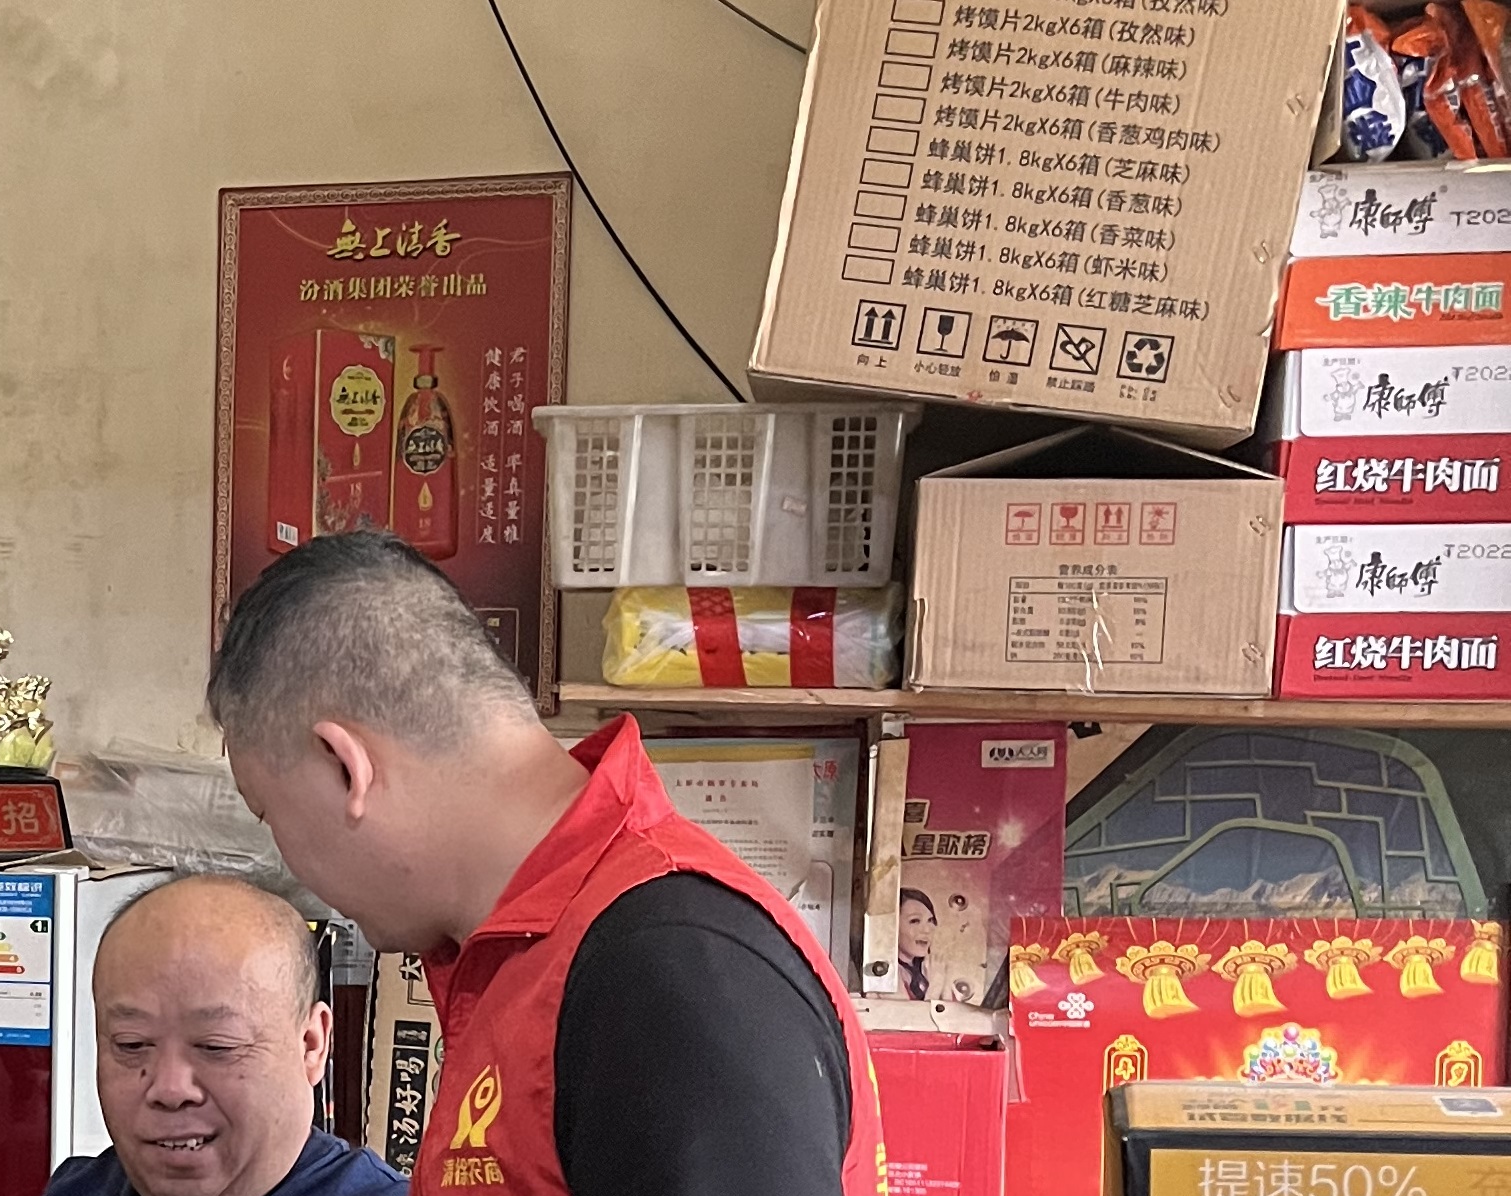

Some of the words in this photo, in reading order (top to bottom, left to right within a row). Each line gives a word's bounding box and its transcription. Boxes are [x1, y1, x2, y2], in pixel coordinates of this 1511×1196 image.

[299, 272, 487, 301] 汾酒集团荣誉出品
[1316, 282, 1504, 322] 香辣牛肉面
[1451, 366, 1511, 382] T202
[1315, 457, 1501, 494] 红烧牛肉面
[1313, 635, 1499, 671] 红烧牛肉面
[0, 800, 41, 836] 招
[903, 833, 988, 856] 星歌榜
